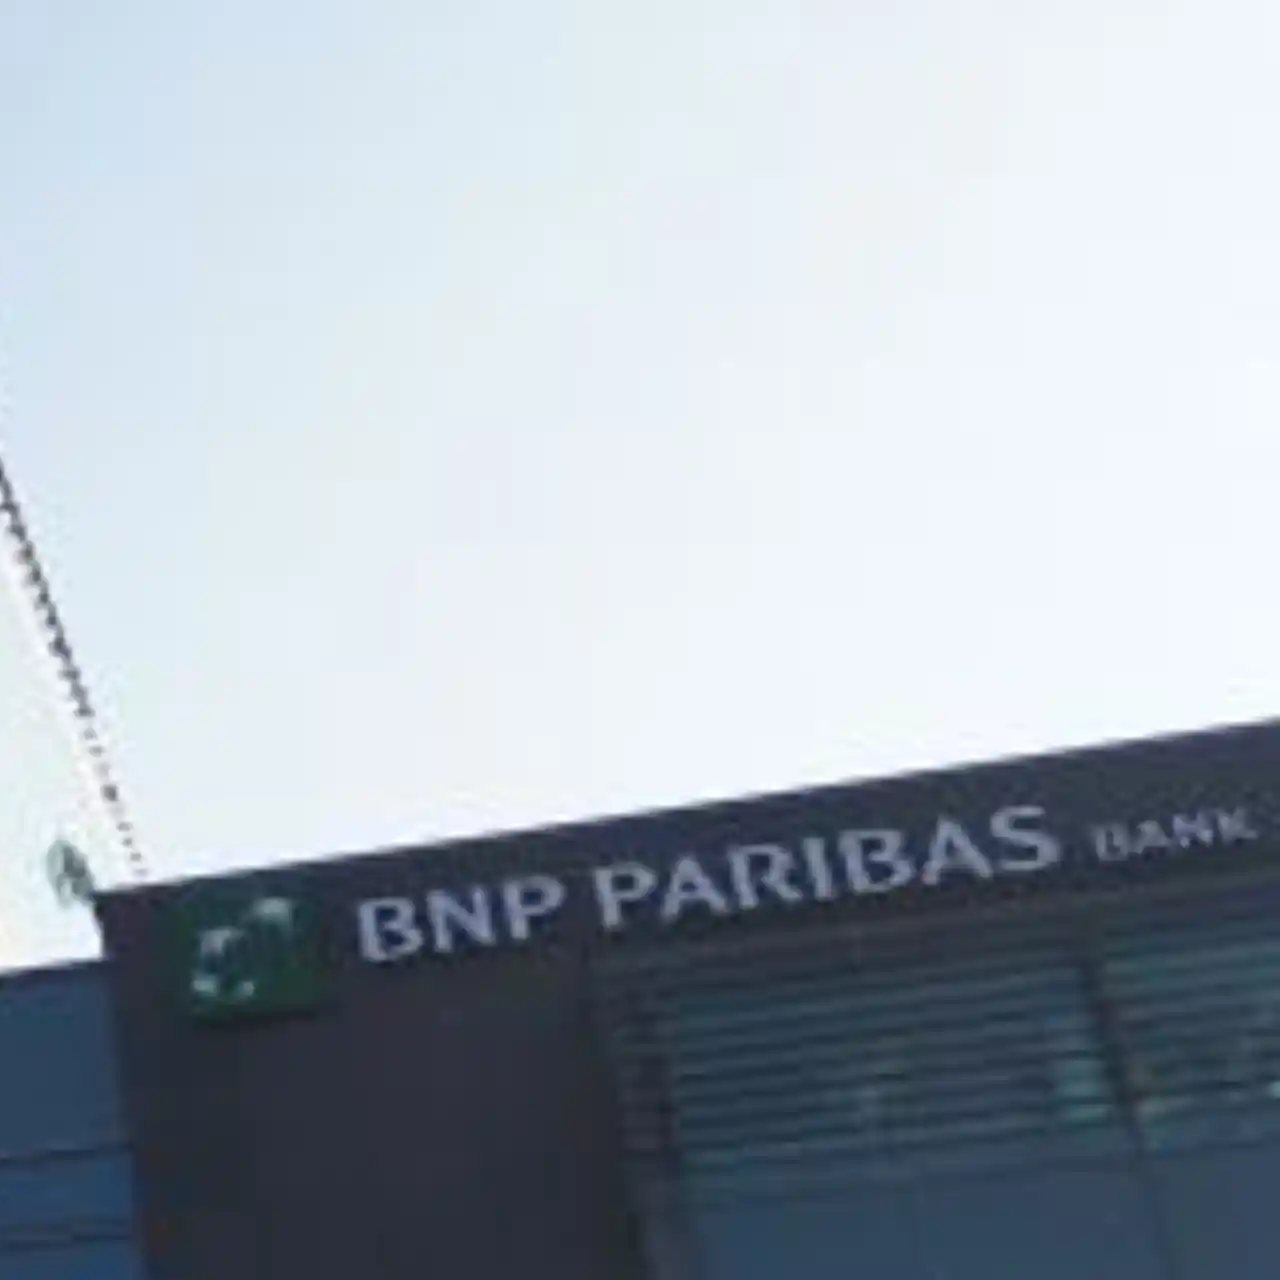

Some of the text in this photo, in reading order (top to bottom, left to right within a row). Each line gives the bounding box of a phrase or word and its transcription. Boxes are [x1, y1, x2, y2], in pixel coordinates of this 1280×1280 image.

[357, 804, 1260, 962] BNP PARIBAS BANK
